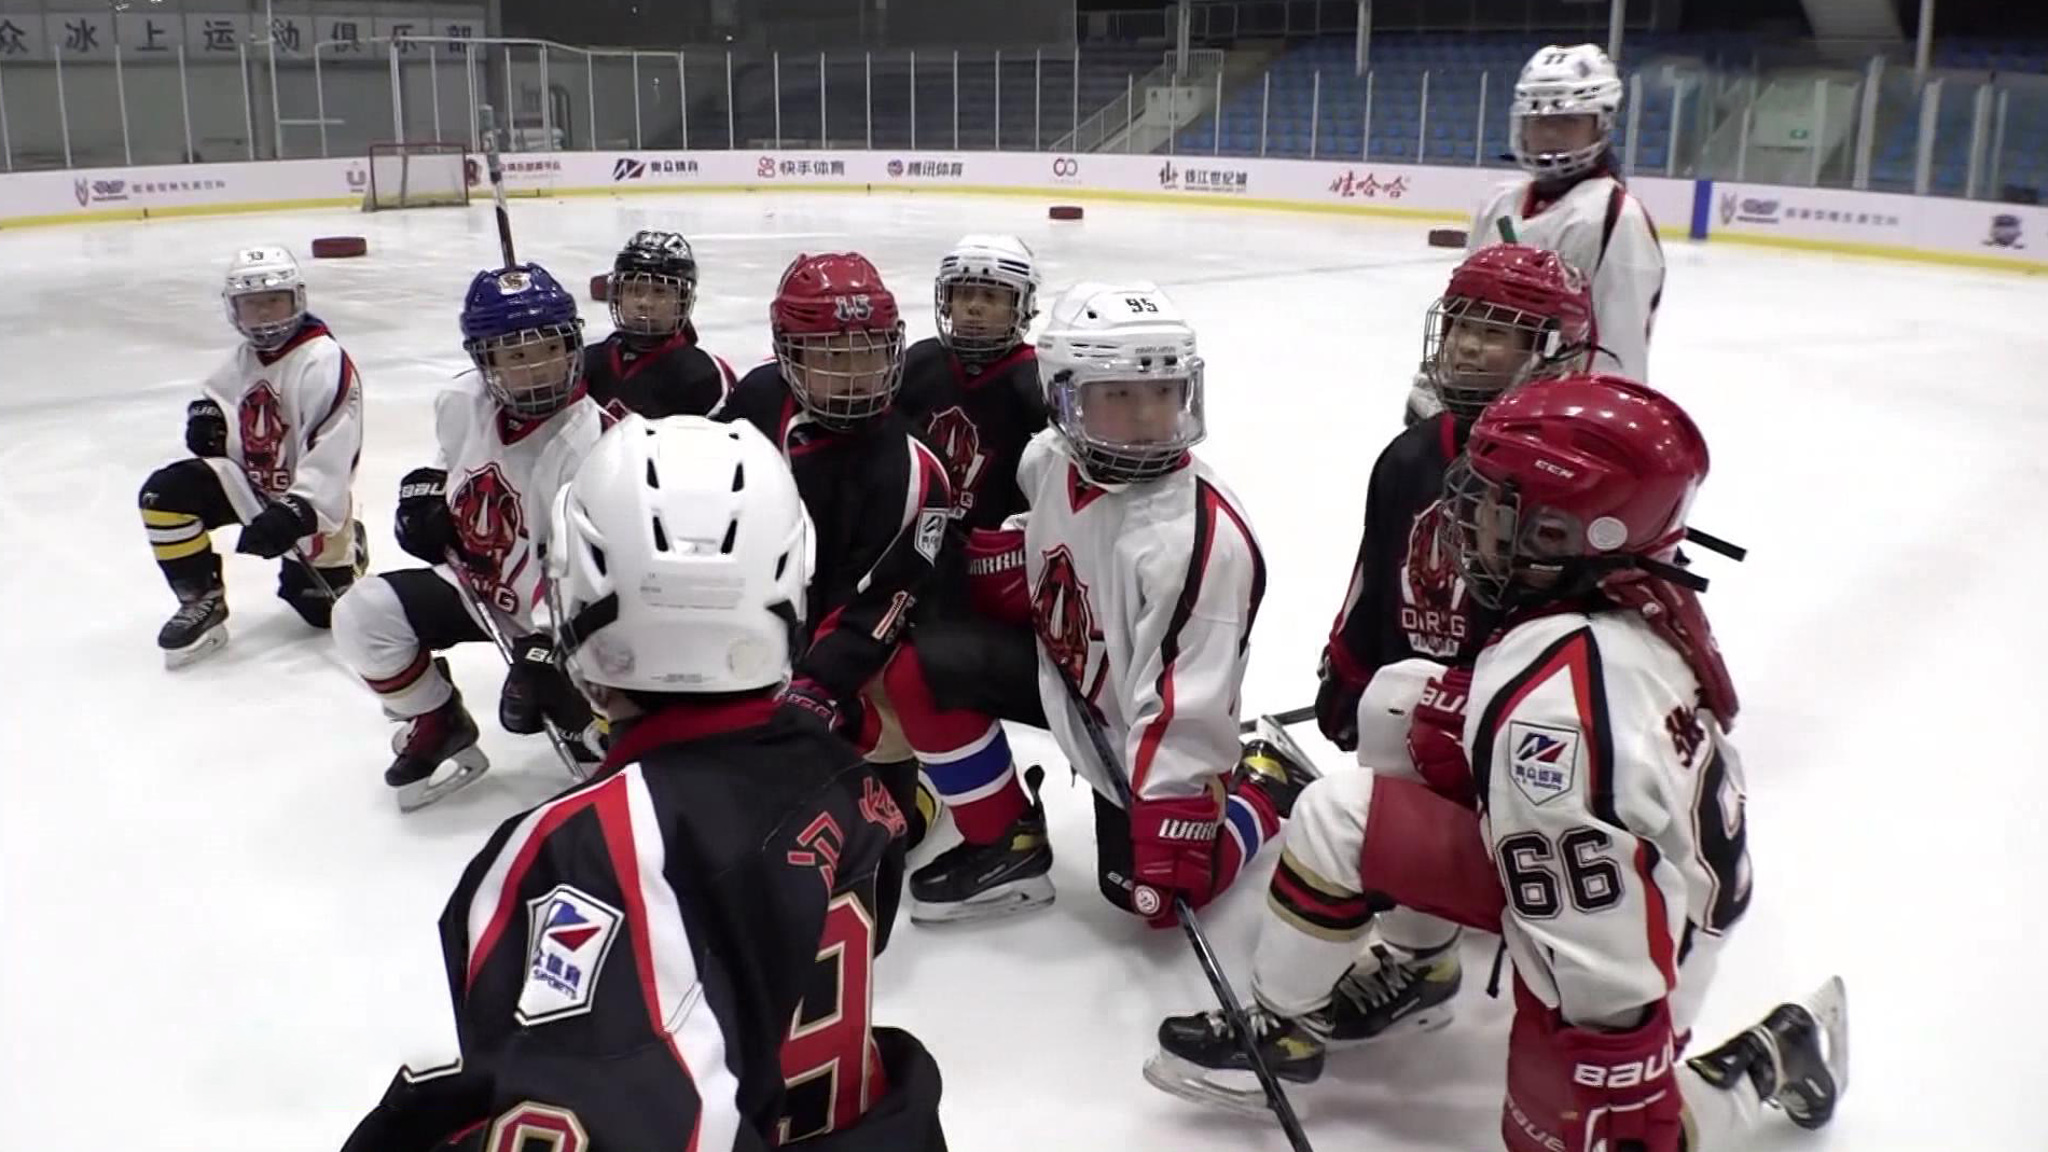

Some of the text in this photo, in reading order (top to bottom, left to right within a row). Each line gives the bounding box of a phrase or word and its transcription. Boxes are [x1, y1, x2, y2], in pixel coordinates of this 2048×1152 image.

[780, 160, 845, 176] 快手体育
[908, 161, 963, 177] 腾讯体育
[1329, 171, 1406, 198] 娃哈哈
[833, 294, 873, 321] 15
[1125, 298, 1159, 312] 95
[1497, 826, 1625, 919] 66
